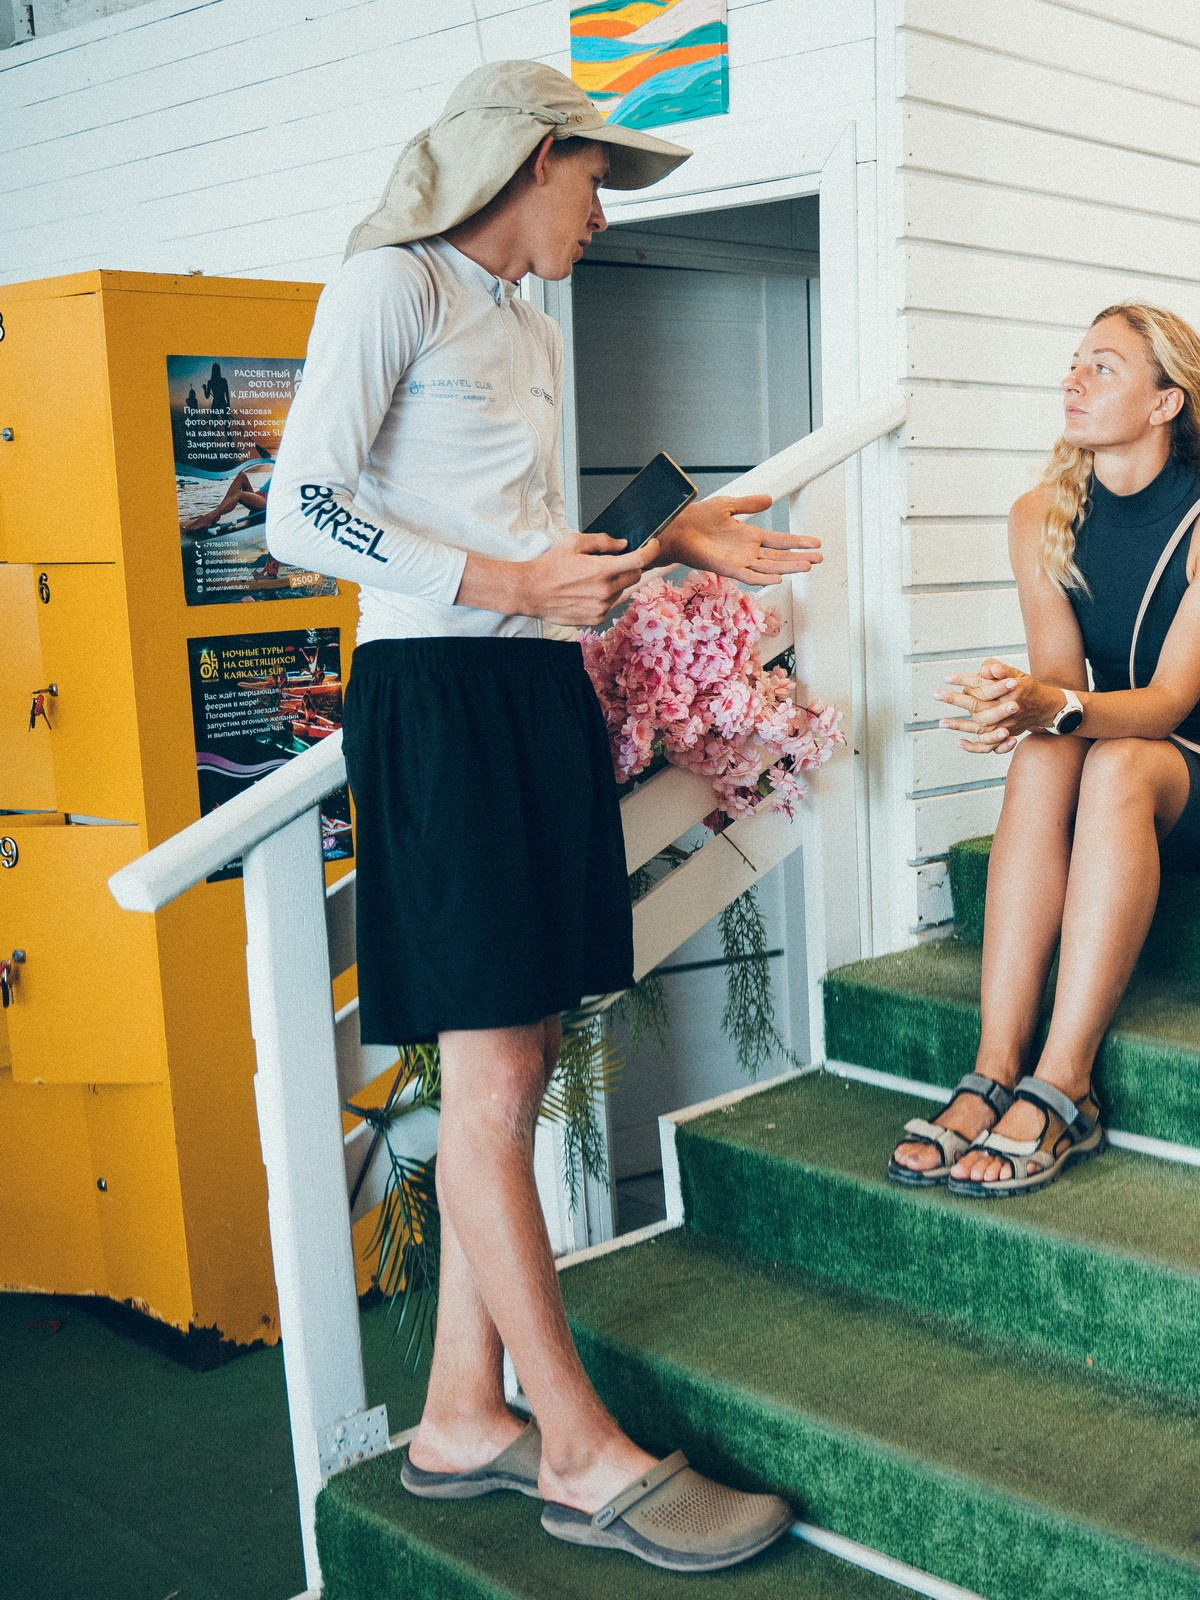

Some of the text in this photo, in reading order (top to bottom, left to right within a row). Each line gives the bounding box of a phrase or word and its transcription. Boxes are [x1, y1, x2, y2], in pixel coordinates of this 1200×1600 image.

[234, 369, 290, 378] РАССВЕТНЫЙ
[248, 380, 291, 388] ФОТО-ТУР
[431, 379, 471, 388] TRAVEL
[475, 381, 494, 391] CLUB
[238, 391, 292, 399] ДЕЛЬФИНАМ
[183, 406, 272, 416] Приятная 2-х часовая
[184, 417, 245, 428] фото-прогулка
[253, 418, 285, 427] рассвет
[243, 430, 271, 438] досках
[272, 428, 283, 437] SU
[187, 440, 256, 450] Зачерпните лучи
[187, 451, 251, 460] солнца веслом!
[291, 575, 313, 586] 2500
[38, 572, 50, 604] 6
[222, 646, 284, 658] НОЧНЫЕ ТУРЫ
[223, 656, 296, 669] НА СВЕТЯЩИХСЯ
[224, 669, 259, 679] КАЯКАХ
[268, 667, 284, 676] SUP
[204, 688, 280, 701] Вас ждёт мерцающая
[205, 702, 232, 711] феерия
[239, 698, 259, 708] море!
[206, 710, 246, 719] Поговорим
[207, 720, 240, 730] запустим
[241, 718, 269, 726] огоньки
[213, 730, 241, 739] выпьем
[241, 726, 271, 736] вкусный
[0, 836, 19, 869] 9
